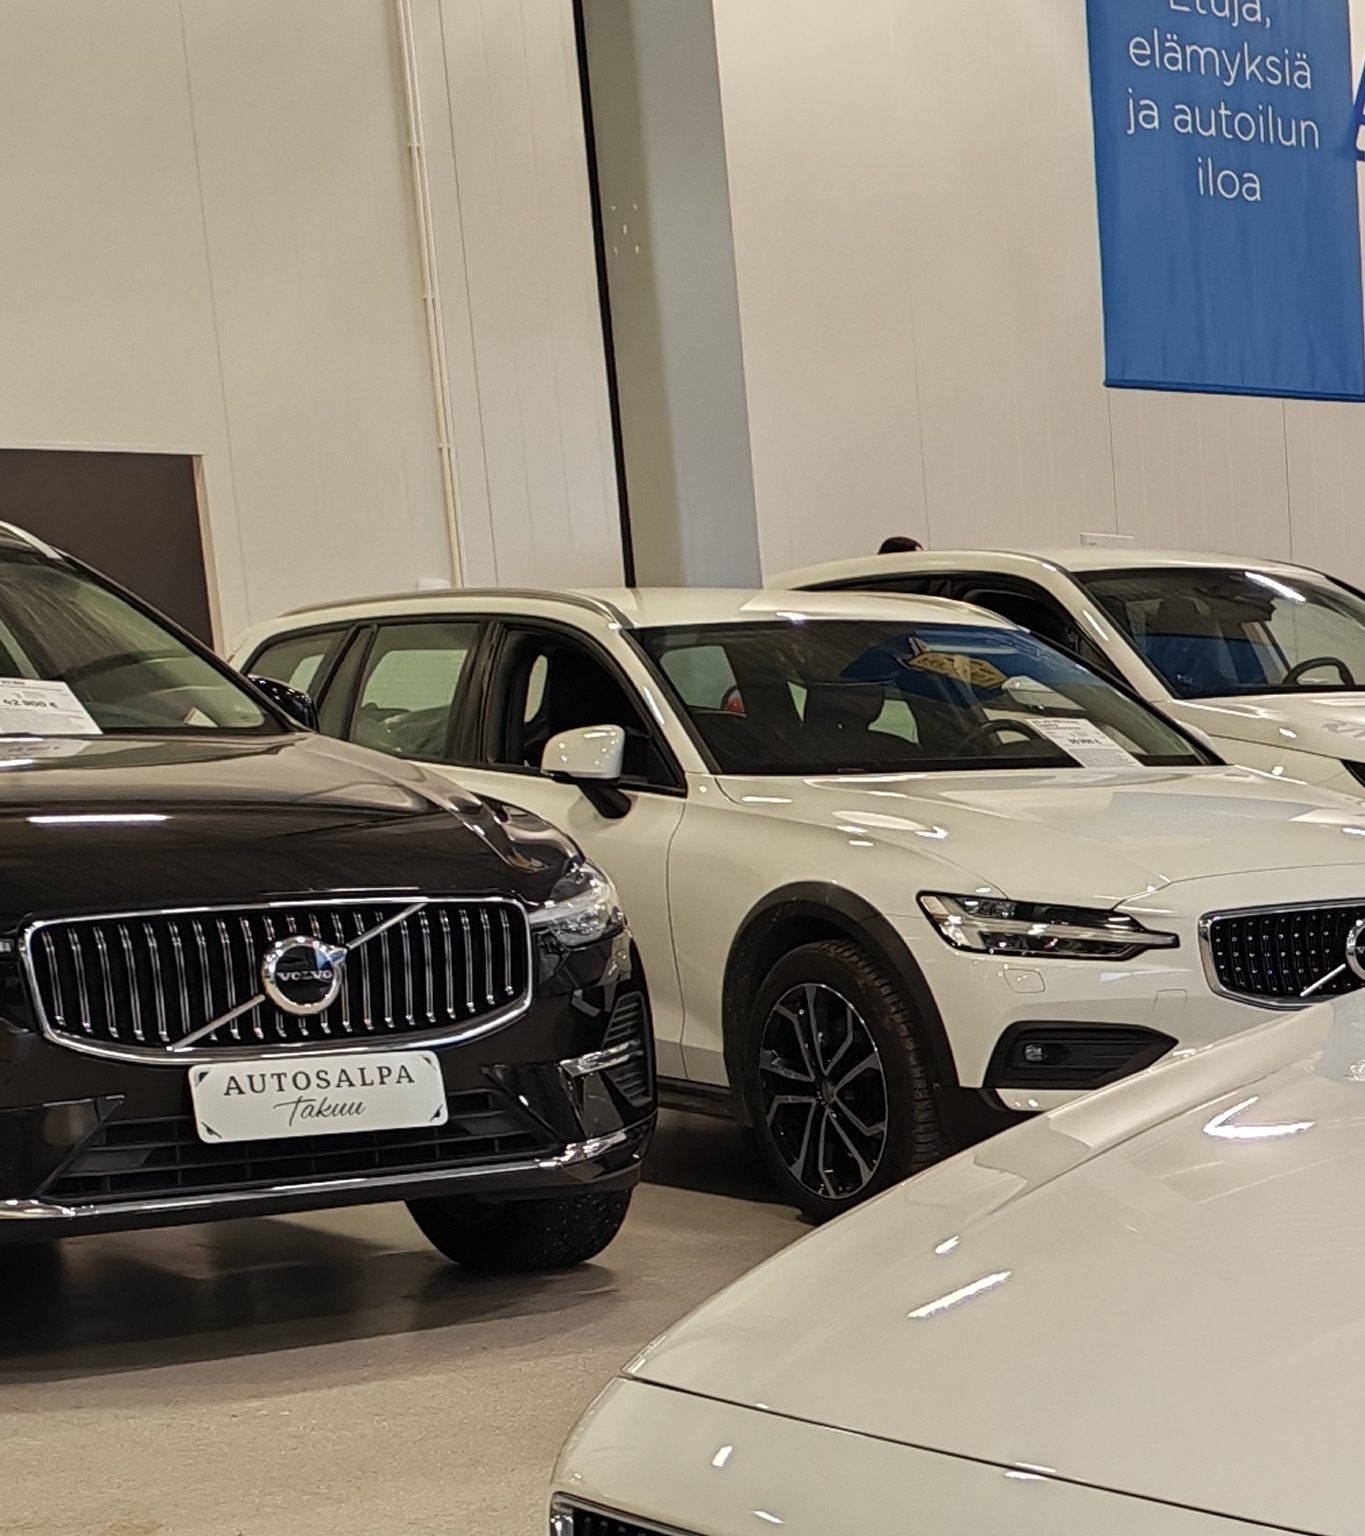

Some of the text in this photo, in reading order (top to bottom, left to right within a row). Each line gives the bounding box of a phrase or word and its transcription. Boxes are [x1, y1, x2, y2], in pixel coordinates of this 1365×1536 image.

[1128, 27, 1312, 90] elämyksiä
[1126, 87, 1320, 150] ja autoilun
[1196, 156, 1262, 202] iloa
[276, 969, 333, 982] VOLVO
[222, 1063, 416, 1097] AUTOSALPA
[272, 1095, 367, 1127] Takuu
